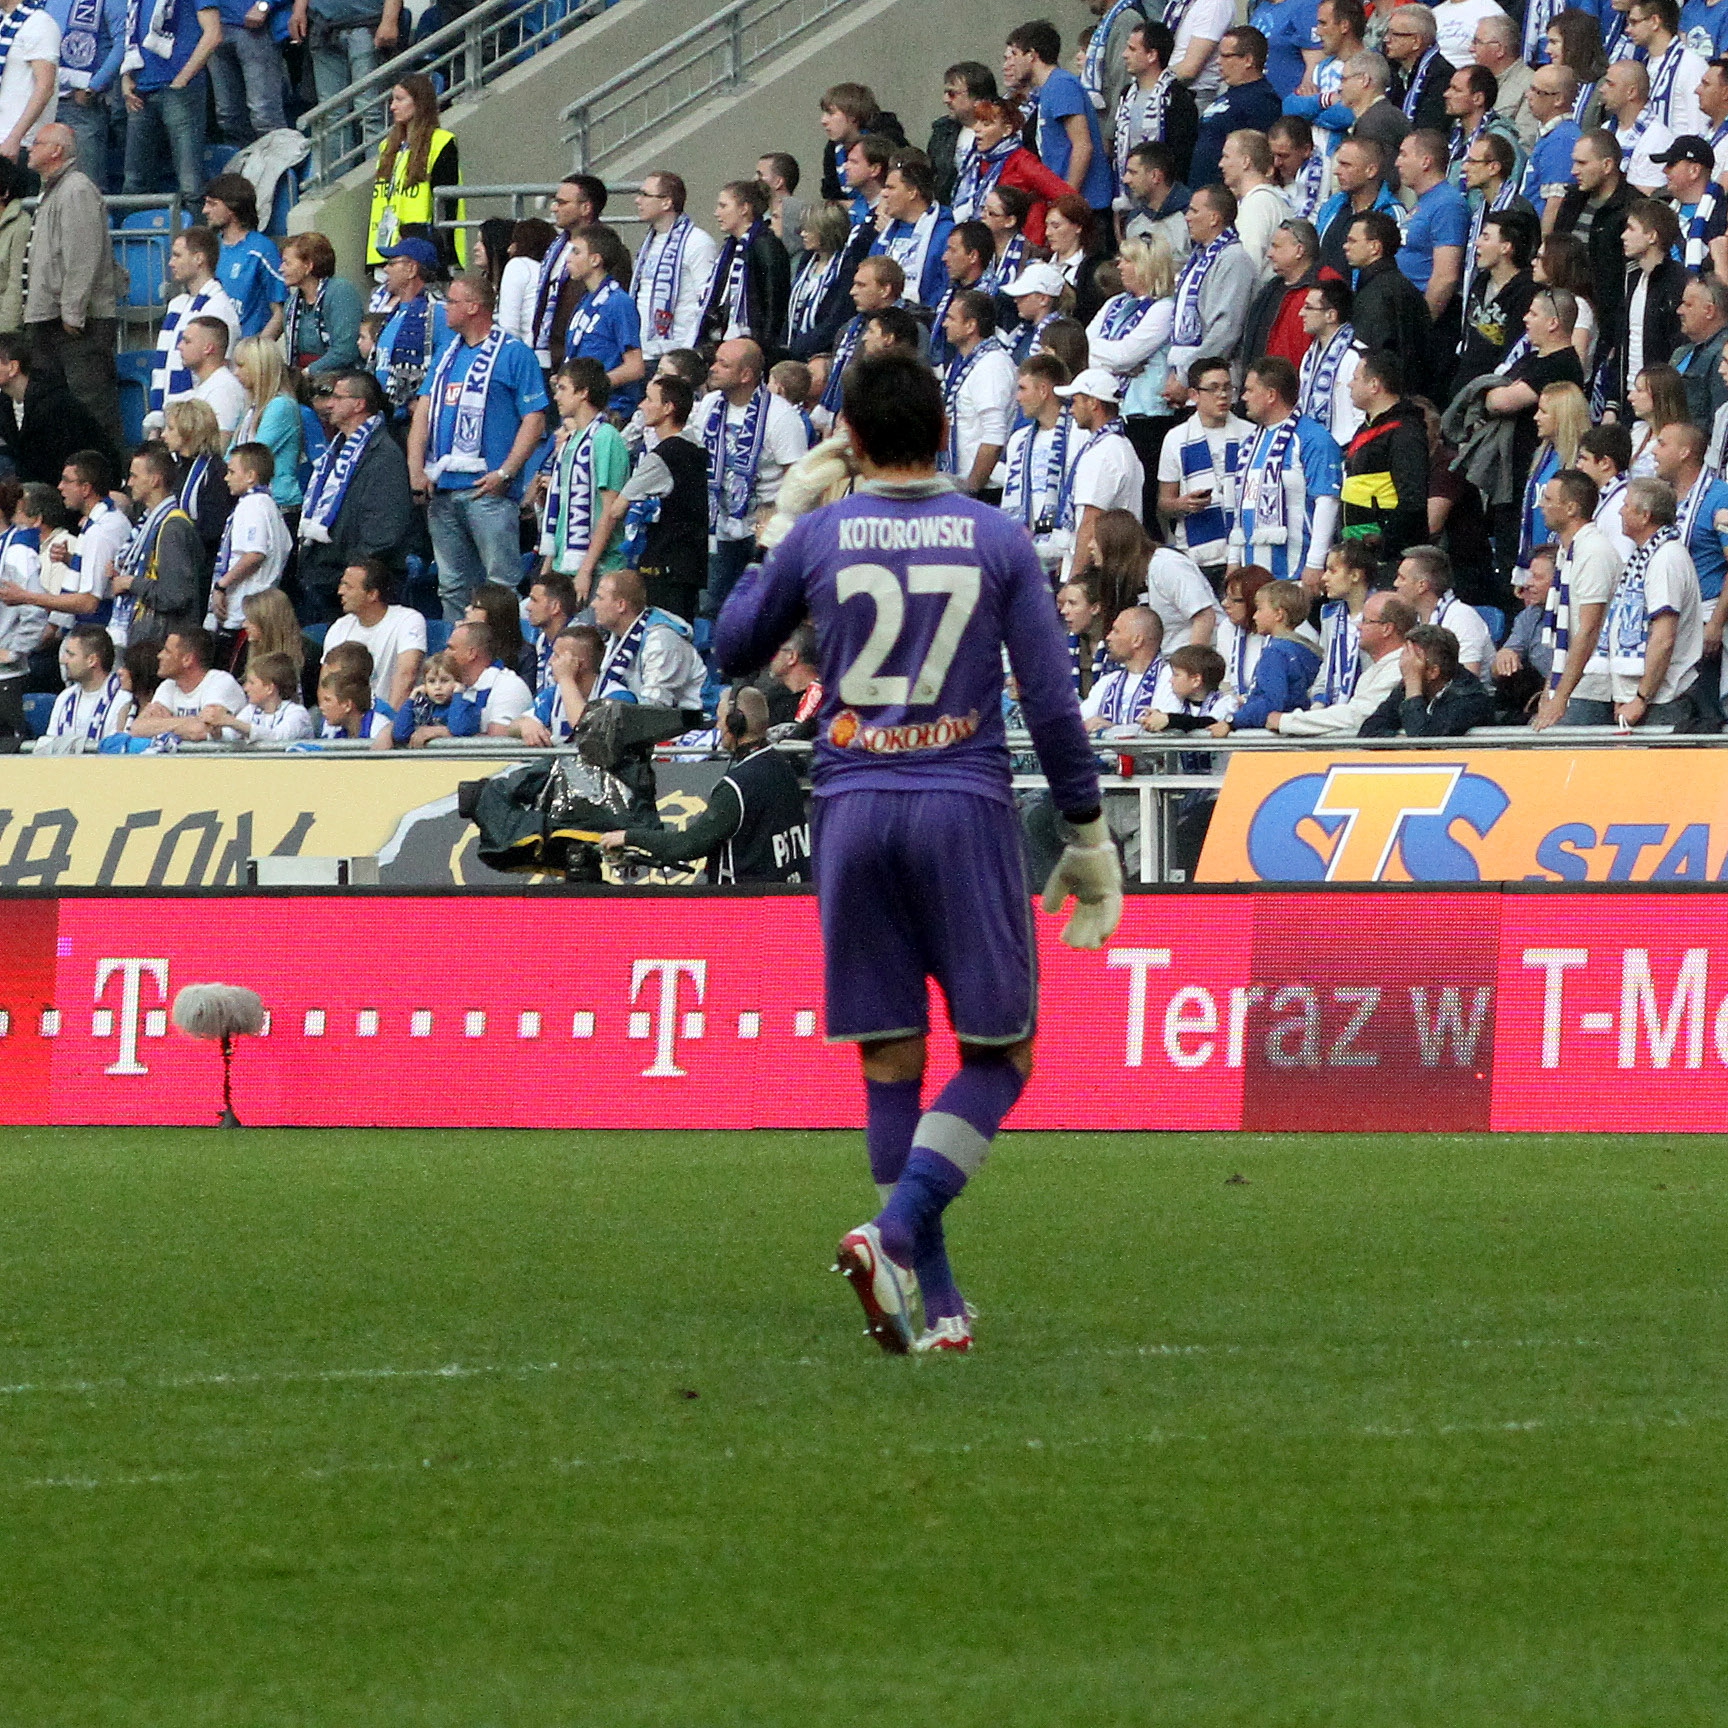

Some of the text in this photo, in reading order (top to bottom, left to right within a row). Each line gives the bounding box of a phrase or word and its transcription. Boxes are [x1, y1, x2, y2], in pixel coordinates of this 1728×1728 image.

[838, 516, 976, 552] KOTOROWSKI
[836, 562, 982, 707] 27
[1247, 762, 1511, 881] STS
[1107, 948, 1382, 1070] Teraz
[1408, 986, 1497, 1069] w
